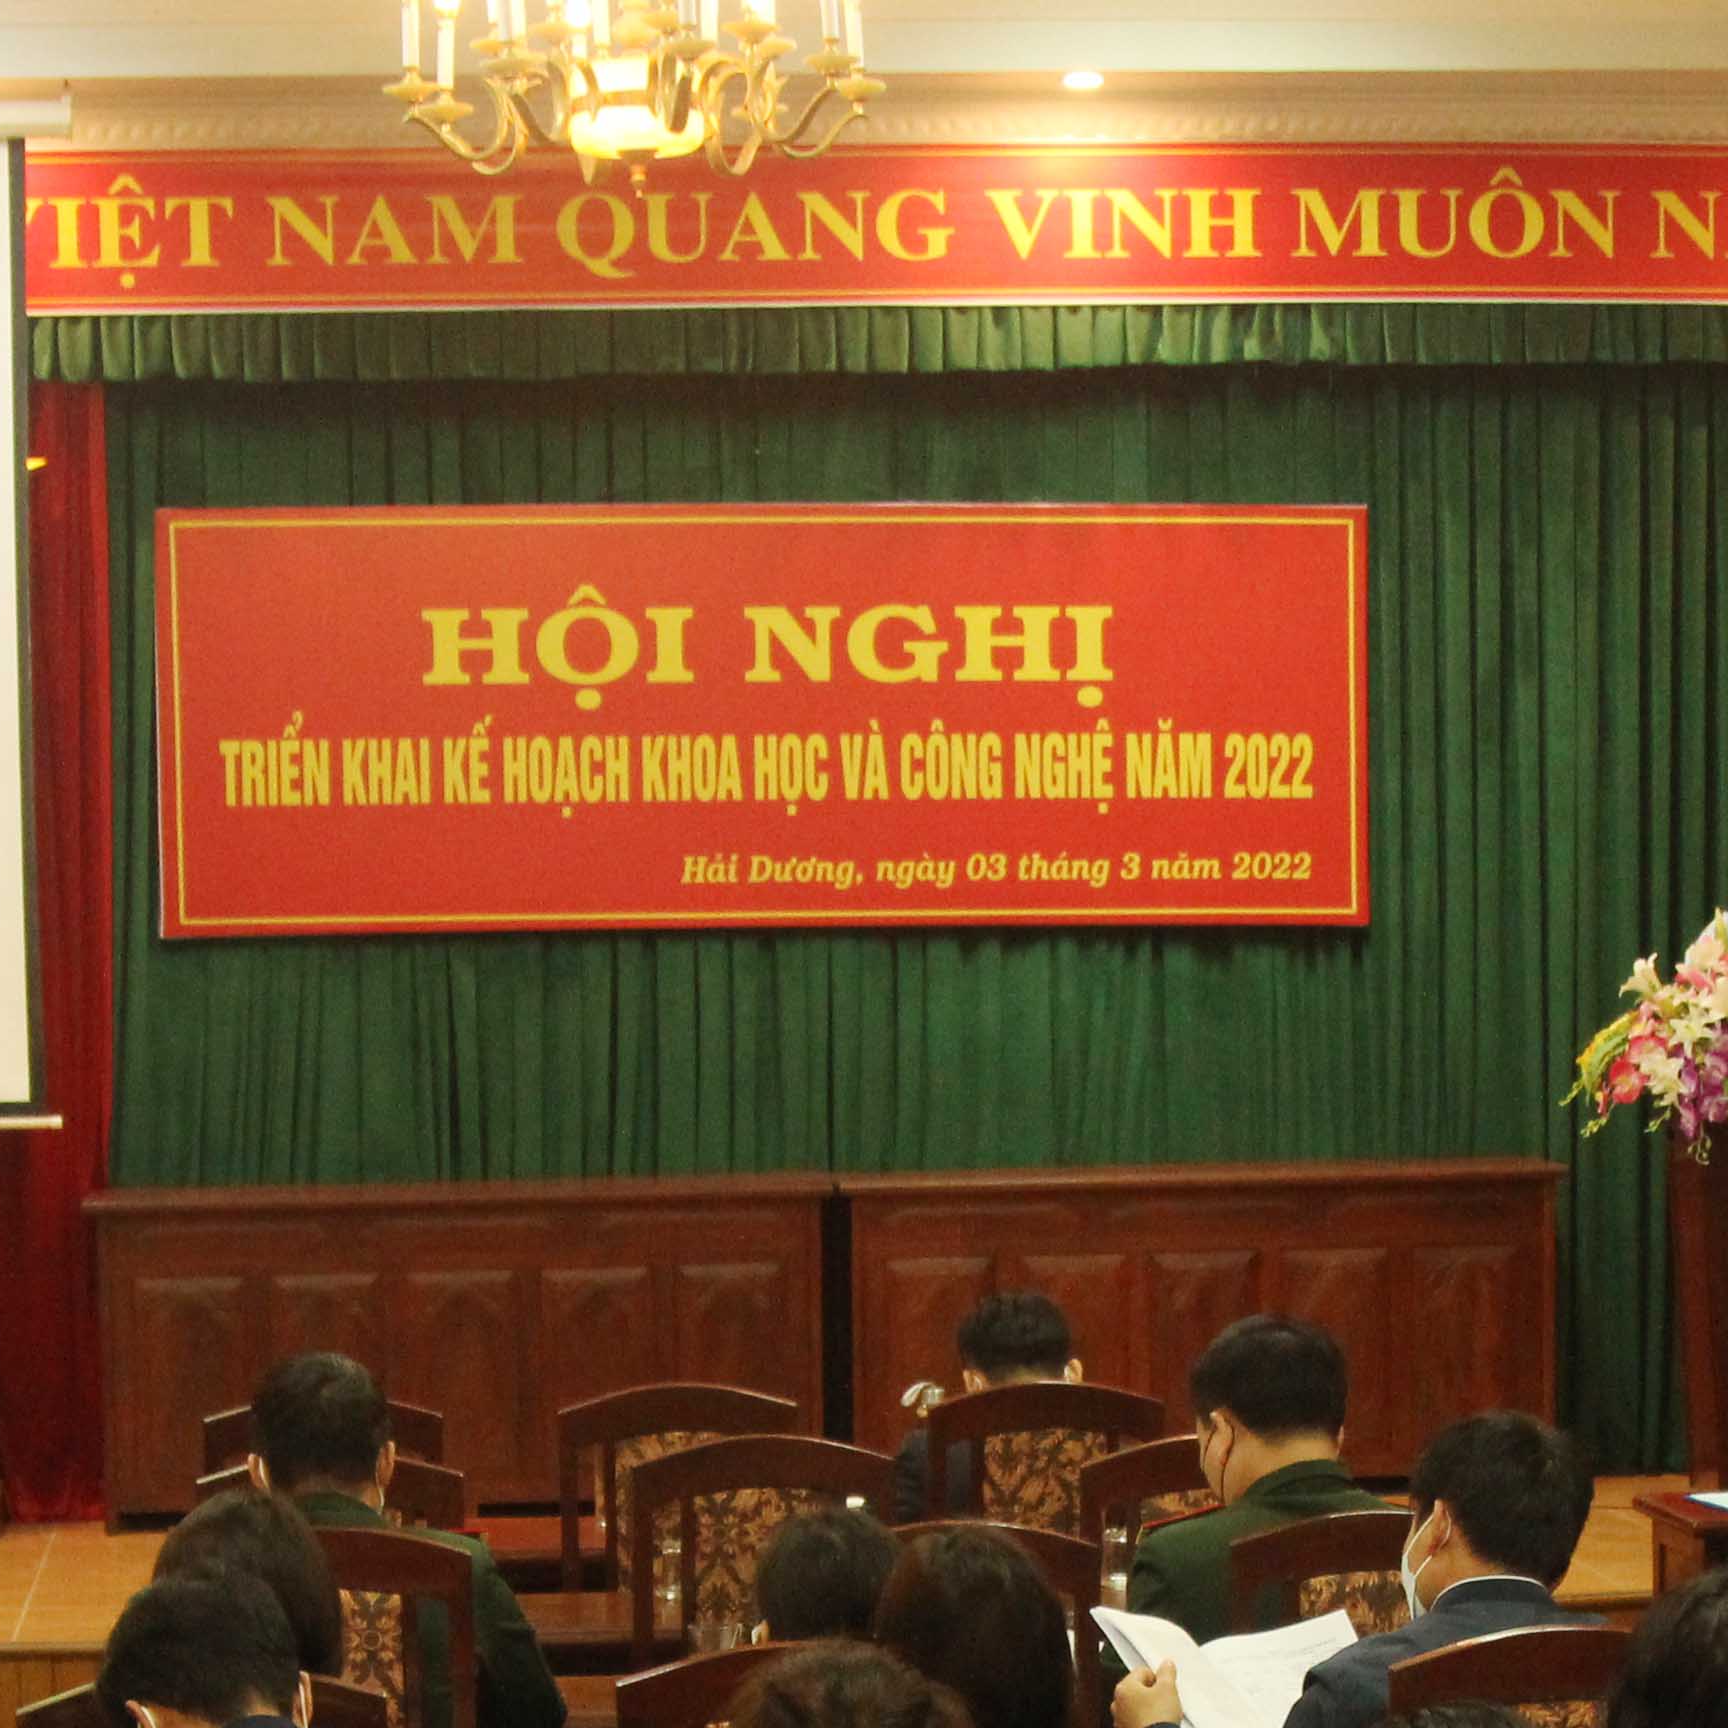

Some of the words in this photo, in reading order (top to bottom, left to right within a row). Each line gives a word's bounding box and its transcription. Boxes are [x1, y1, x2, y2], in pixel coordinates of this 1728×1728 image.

[26, 174, 234, 289] IỆT
[266, 194, 524, 265] NAM
[556, 188, 956, 278] QUANG
[984, 187, 1262, 259] VINH
[1290, 166, 1622, 259] MUÔN
[420, 584, 695, 710] HỘI
[744, 603, 1114, 708] NGHỊ
[218, 711, 331, 808] TRIỂN
[341, 737, 432, 806] KHAI
[443, 715, 492, 805] KẾ
[502, 734, 631, 818] HOẠCH
[640, 734, 743, 802] KHOA
[753, 732, 829, 816] HỌC
[839, 718, 889, 800] VÀ
[900, 718, 1003, 800] CÔNG
[1013, 717, 1114, 814] NGHỆ
[1125, 717, 1213, 799] NĂM
[1223, 732, 1314, 799] 2022
[680, 852, 739, 884] Hải
[748, 853, 864, 889] Dương,
[876, 852, 955, 889] ngày
[965, 853, 1007, 881] 03
[1017, 851, 1111, 888] tháng
[1120, 852, 1142, 881] 3
[1151, 852, 1222, 880] năm
[1231, 852, 1312, 881] 2022
